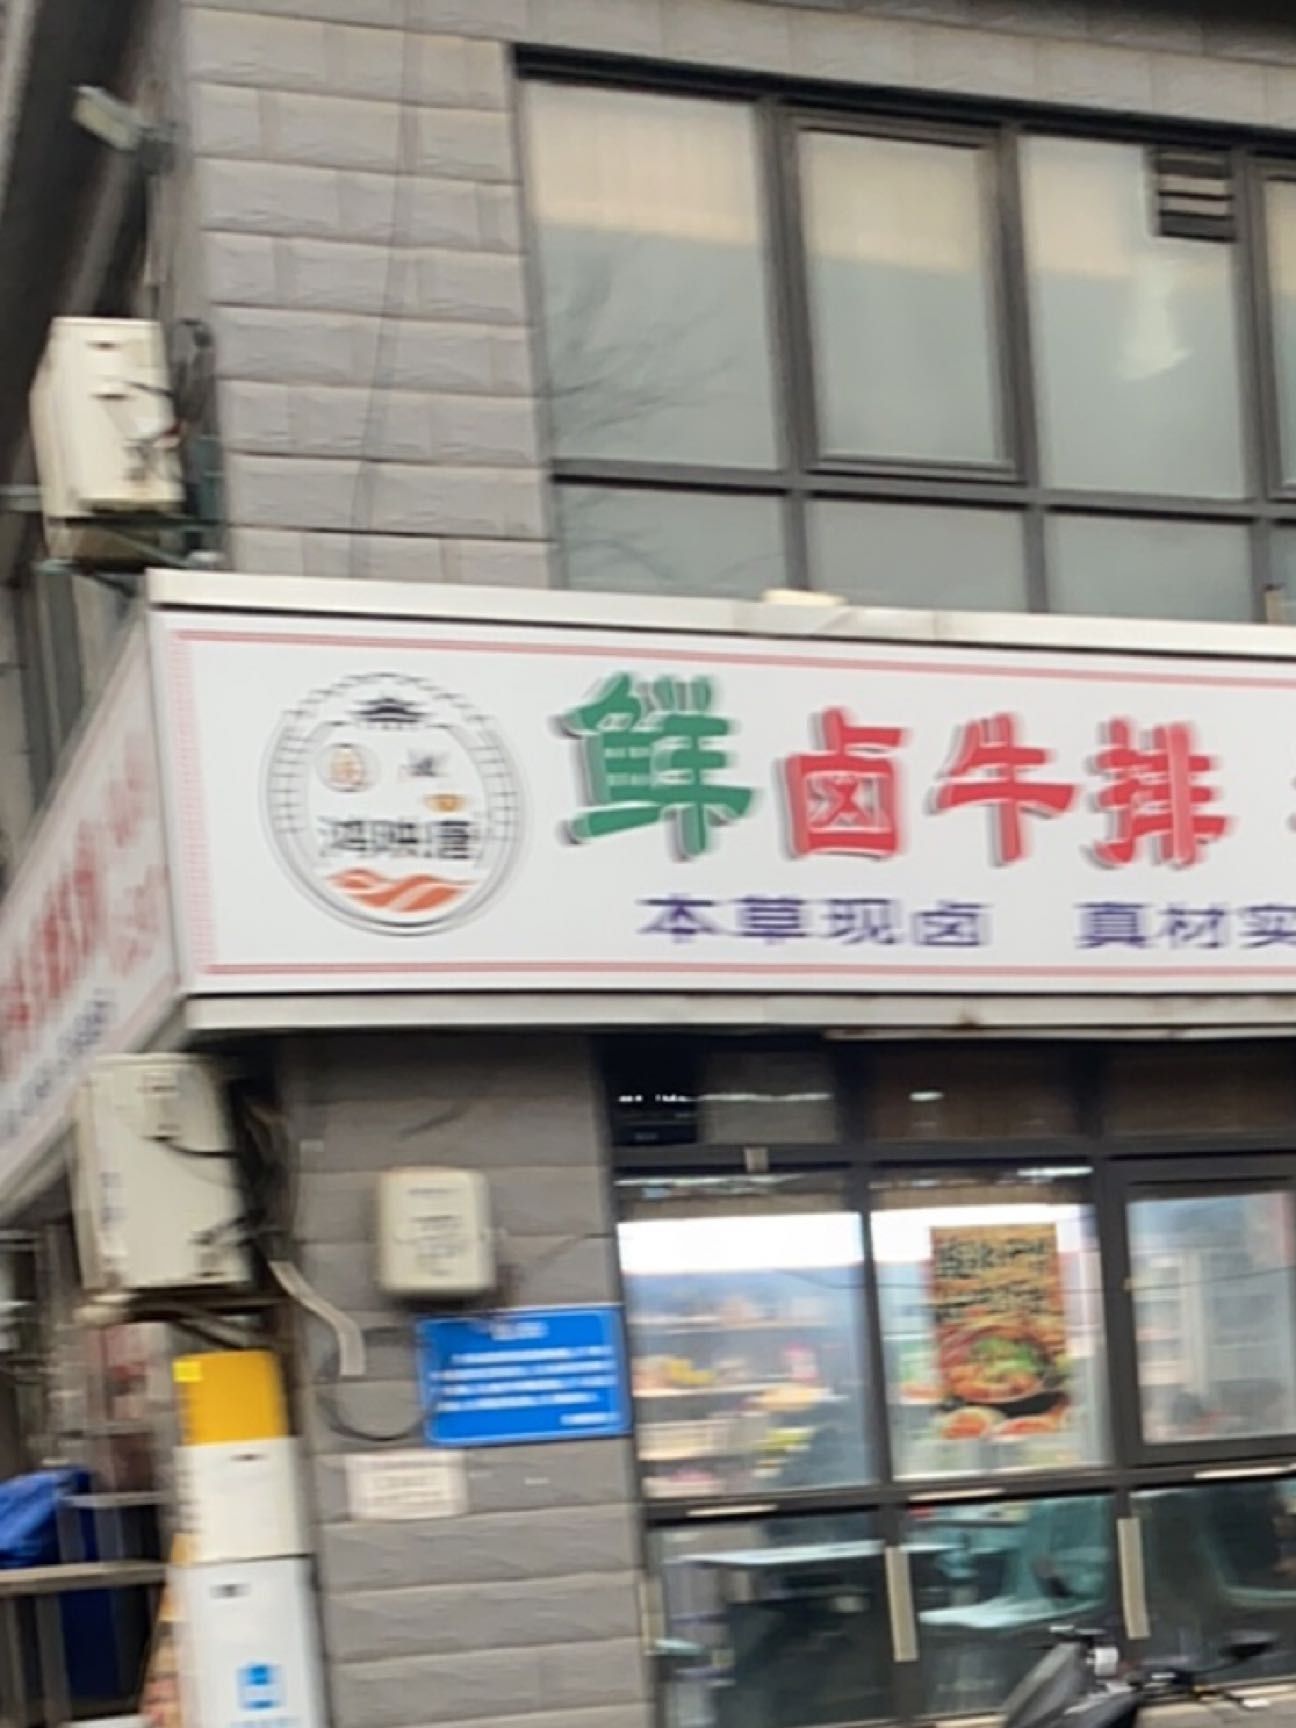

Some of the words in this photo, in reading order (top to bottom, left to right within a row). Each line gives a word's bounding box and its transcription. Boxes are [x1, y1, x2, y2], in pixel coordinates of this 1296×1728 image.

[552, 671, 1232, 868] 鲜卤牛排
[636, 897, 990, 948] 本草现卤
